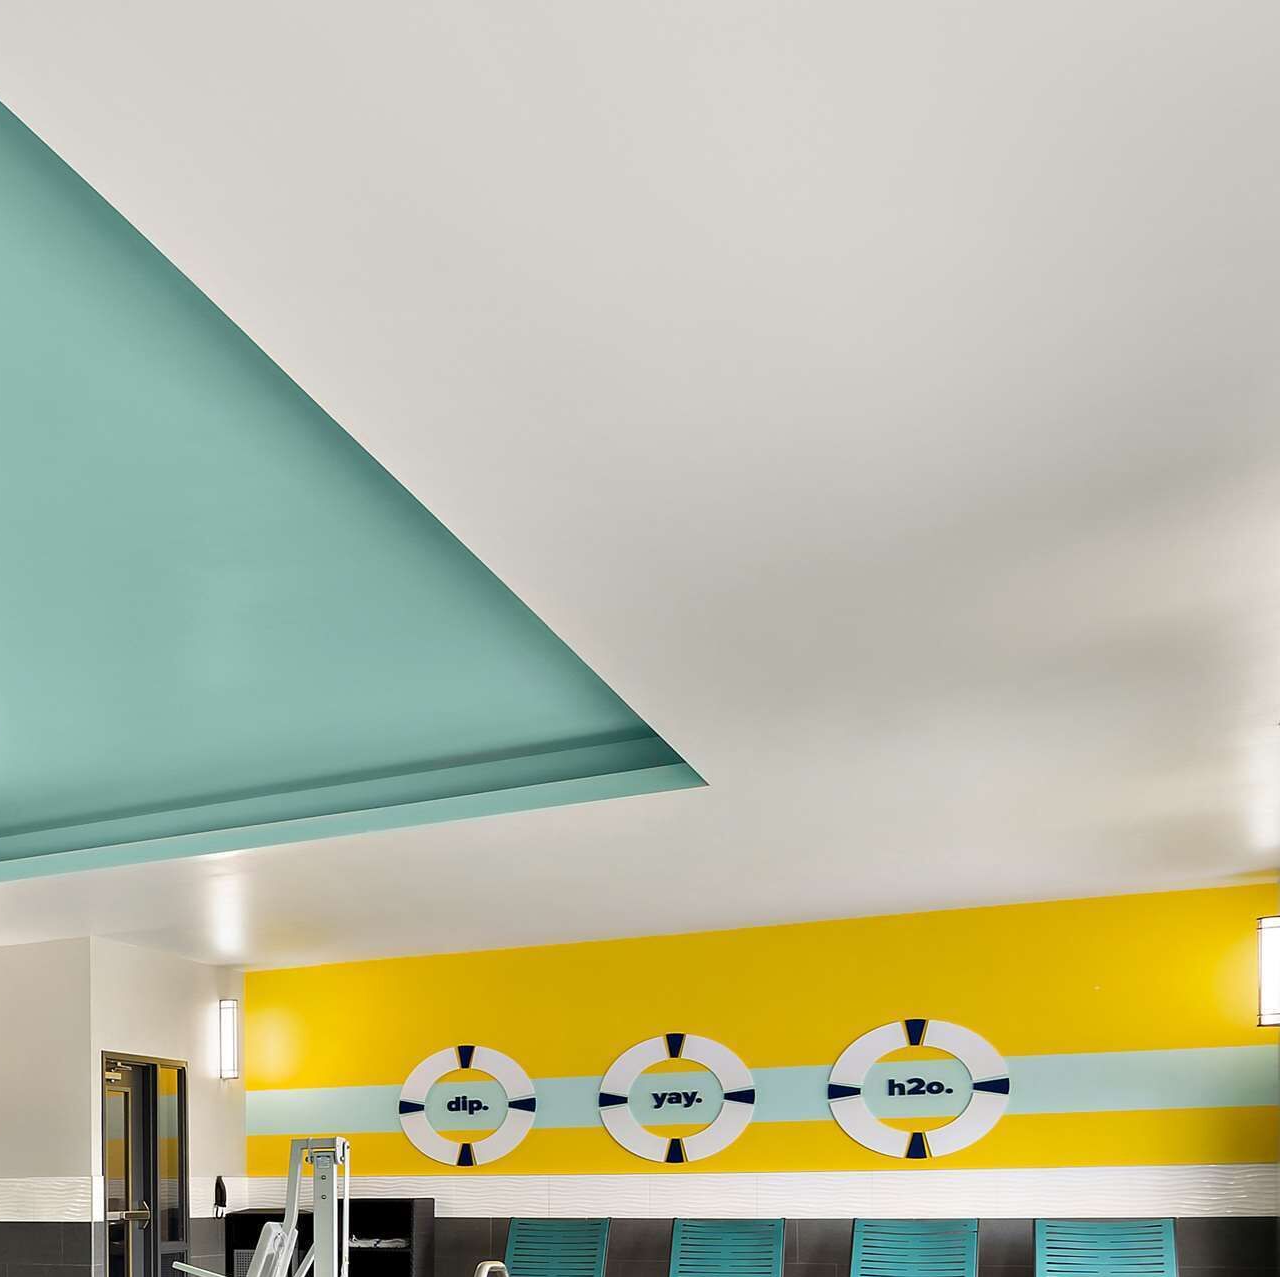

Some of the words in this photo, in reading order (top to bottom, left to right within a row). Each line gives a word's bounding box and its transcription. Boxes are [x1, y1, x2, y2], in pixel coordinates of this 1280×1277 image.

[887, 1077, 954, 1098] h2o.
[446, 1095, 490, 1116] dip.
[651, 1088, 704, 1110] yay.
